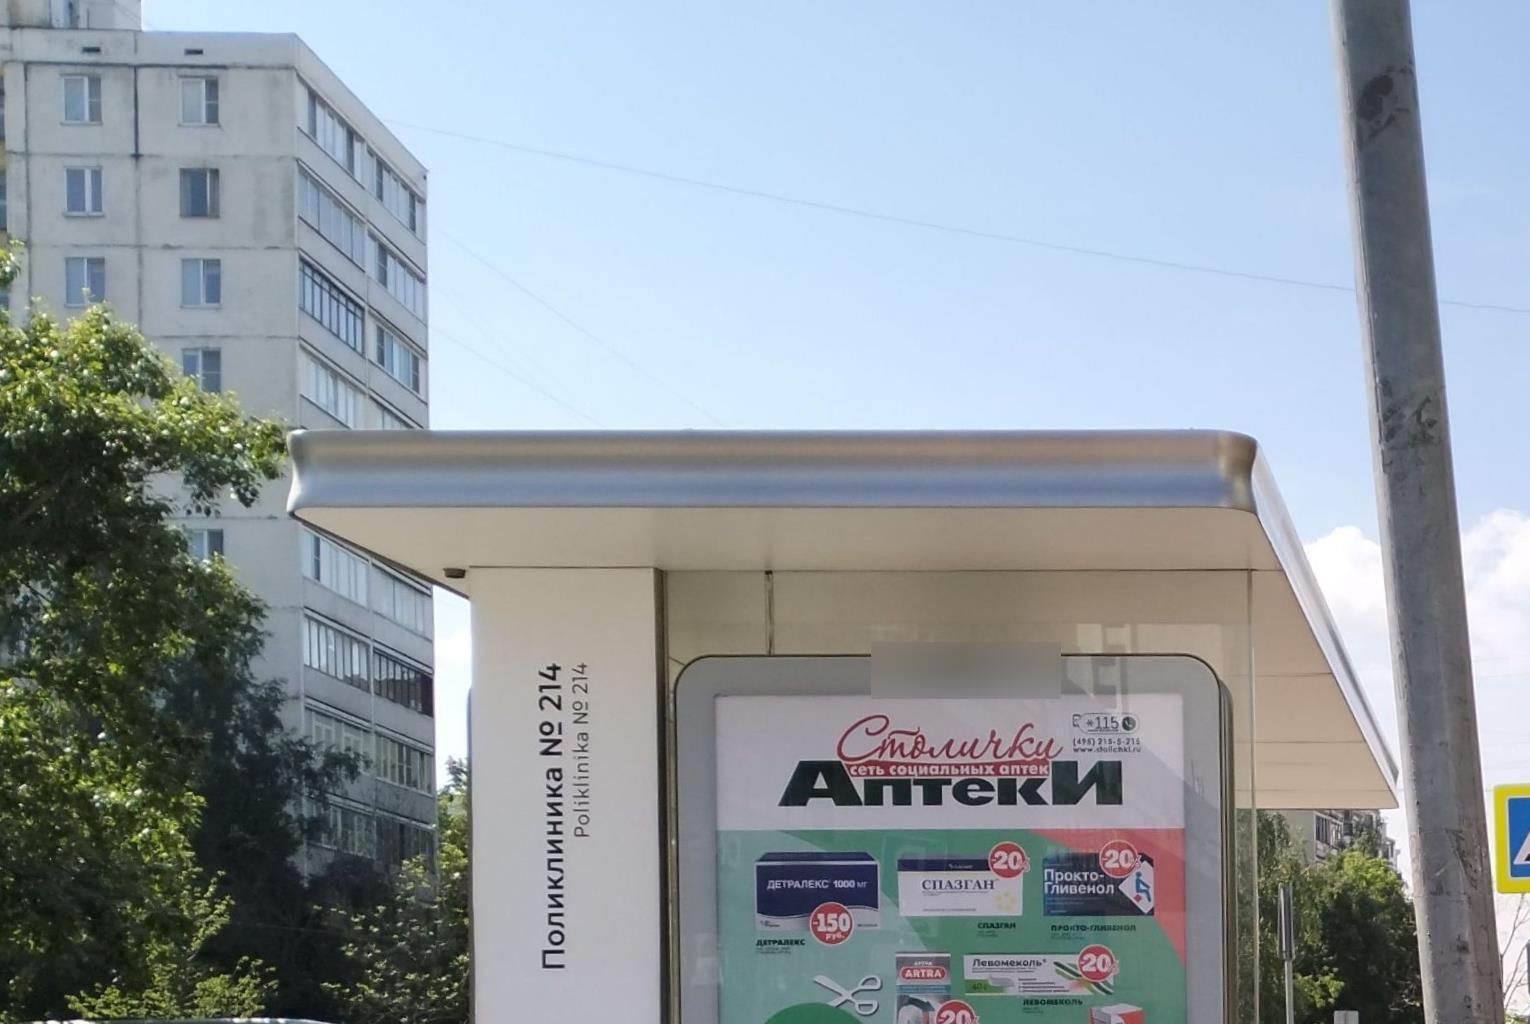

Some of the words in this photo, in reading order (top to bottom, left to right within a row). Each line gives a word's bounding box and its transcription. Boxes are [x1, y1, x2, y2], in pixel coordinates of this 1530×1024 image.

[571, 662, 589, 695] 214
[538, 663, 563, 711] 214
[837, 714, 1064, 761] Столички
[1072, 737, 1095, 747] (495)
[850, 765, 885, 776] сеть
[889, 764, 995, 778] социальных
[999, 764, 1049, 775] аптек
[571, 731, 590, 837] Poliklinika
[541, 767, 565, 968] Поликлиника
[1044, 868, 1105, 884] Прокто-
[766, 879, 830, 890] ДЕТРАЛЕКС
[833, 880, 855, 889] 1000
[921, 879, 995, 890] СПАЗГАН
[1044, 881, 1115, 895] Гливенол
[812, 912, 851, 932] -150
[756, 938, 806, 947] ДЕТРАЛЕКС
[972, 957, 1043, 968] Левомеколь
[904, 969, 943, 979] ARTRA
